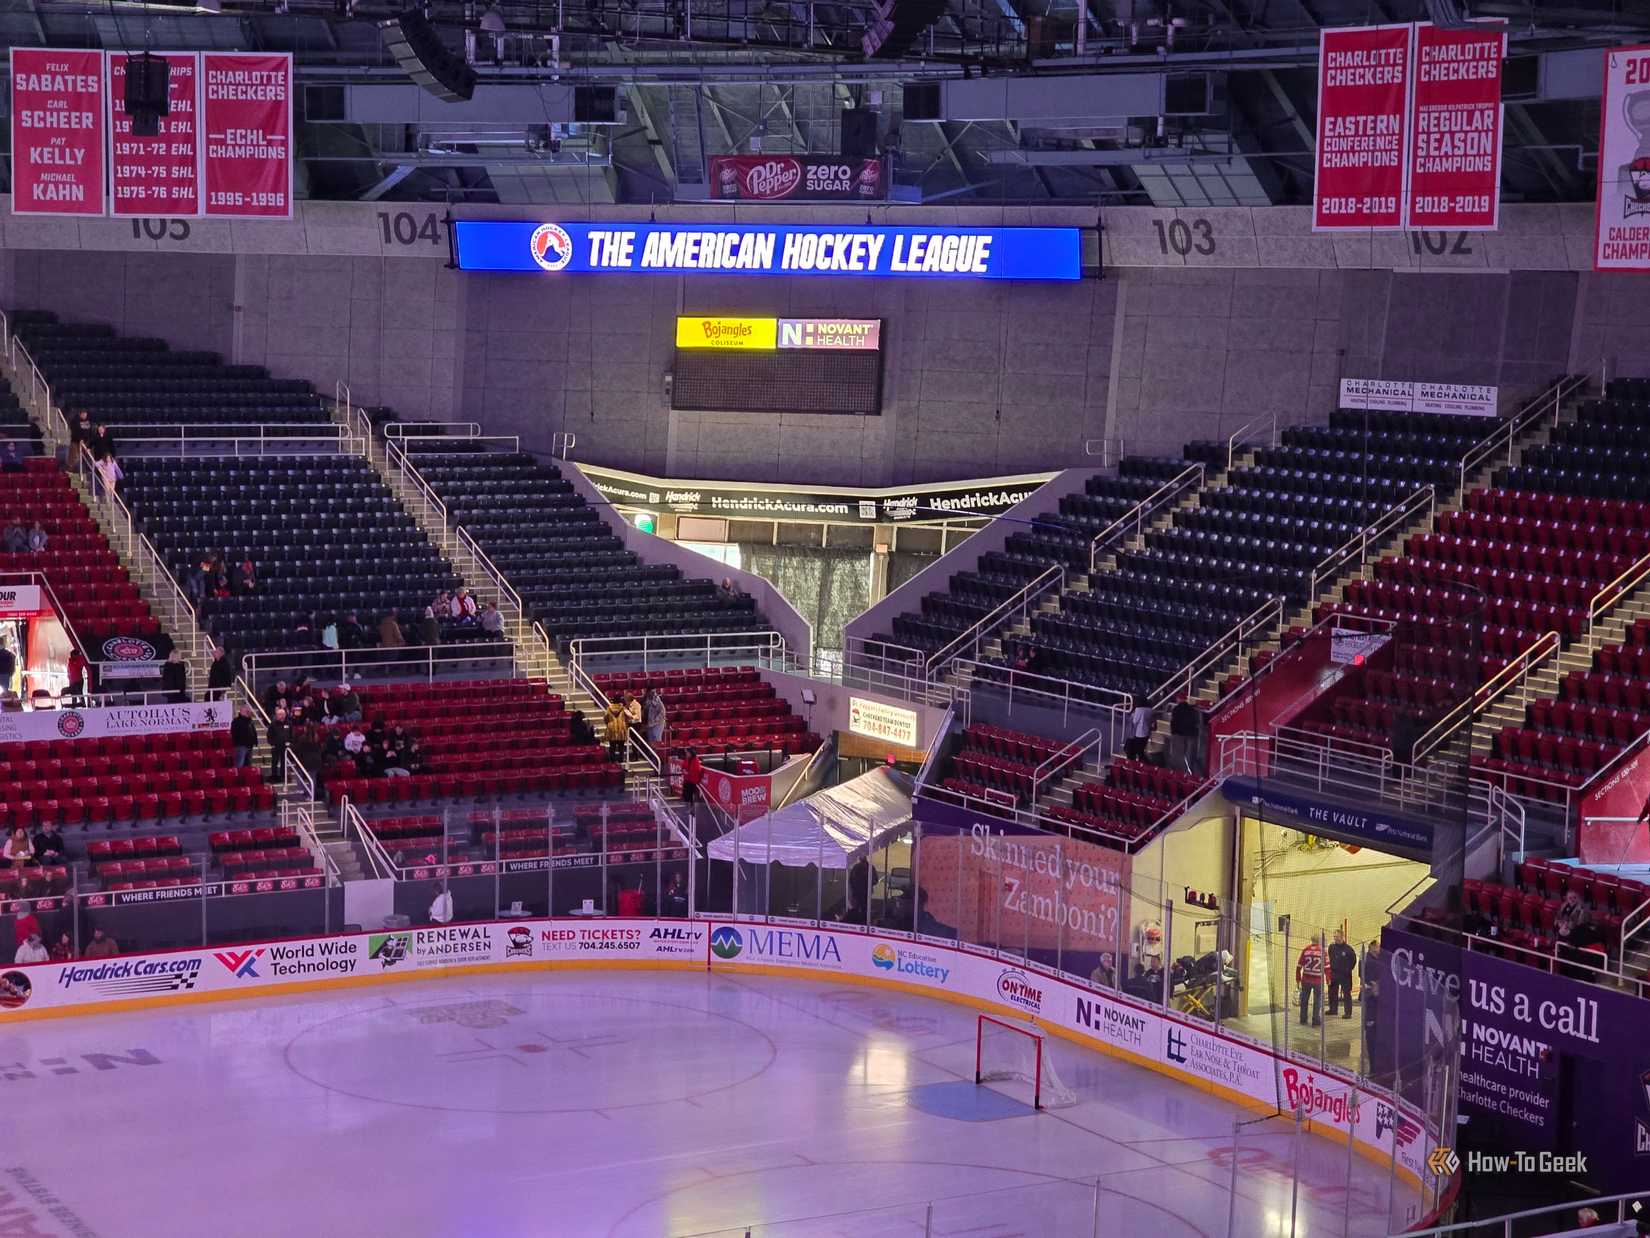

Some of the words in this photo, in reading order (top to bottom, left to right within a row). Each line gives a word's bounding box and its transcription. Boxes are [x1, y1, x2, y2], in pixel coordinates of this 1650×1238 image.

[1328, 48, 1403, 68] CHARLOTTE
[1422, 42, 1498, 62] CHARLOTTE
[46, 64, 69, 72] FELIX
[1328, 66, 1402, 86] CHECKERS
[1421, 60, 1496, 82] CHECKERS
[16, 74, 98, 92] SABATES
[208, 70, 285, 84] CHARLOTTE
[208, 84, 285, 100] CHECKERS
[48, 100, 68, 108] CARL
[170, 100, 192, 112] EHL
[22, 110, 93, 128] SCHEER
[170, 122, 192, 132] EHL
[1325, 114, 1400, 136] EASTERN
[1419, 110, 1494, 132] REGULAR
[226, 129, 268, 144] ECHL
[1324, 136, 1398, 152] CONFERENCE
[1418, 132, 1492, 156] SEASON
[30, 147, 86, 164] KELLY
[116, 143, 166, 155] 1971-72
[172, 144, 194, 155] EHL
[209, 146, 286, 159] CHAMPIONS
[1323, 151, 1398, 168] CHAMPIONS
[1416, 156, 1492, 173] CHAMPIONS
[41, 172, 76, 182] MICHAEL
[116, 166, 166, 178] 1974-75
[172, 166, 194, 178] SHL
[766, 162, 784, 176] Dr
[806, 165, 850, 180] zero
[753, 164, 796, 194] Pepper
[806, 180, 850, 191] SUGAR
[32, 184, 84, 201] KAHN
[116, 186, 167, 198] 1975-76
[172, 186, 194, 198] SHL
[210, 192, 284, 206] 1995-1996
[1322, 197, 1396, 214] 2018-2019
[1416, 196, 1489, 213] 2018-2019
[132, 218, 190, 240] 105
[377, 212, 442, 246] 104
[1153, 219, 1216, 256] 103
[1609, 227, 1650, 241] CALDER
[588, 231, 636, 268] THE
[640, 231, 776, 270] AMERICAN
[780, 233, 884, 272] HOCKEY
[890, 234, 992, 272] LEAGUE
[702, 321, 752, 338] Bojangles
[818, 324, 871, 334] NOVANT
[818, 336, 865, 346] HEALTH
[1346, 380, 1413, 389] CHARLOTTE
[1346, 387, 1414, 397] MECHANICAL
[1421, 384, 1492, 394] CHARLOTTE
[1420, 391, 1492, 401] MECHANICAL
[712, 496, 848, 515] HendrickAcura.com
[106, 718, 139, 729] LAKE
[140, 716, 190, 728] NORMAN
[107, 708, 191, 722] AUTOHAUS
[1309, 807, 1328, 821] THE
[1332, 812, 1368, 829] VAULT
[510, 860, 538, 870] WHERE
[573, 856, 594, 867] MEET
[1066, 858, 1120, 896] your
[122, 891, 154, 902] WHERE
[155, 888, 193, 900] FRIENDS
[194, 886, 218, 898] MET
[1004, 876, 1118, 941] Zamboni?
[417, 926, 491, 945] RENEWAL
[542, 930, 576, 941] NEED
[580, 930, 642, 940] TICKETS?
[270, 944, 315, 960] World
[318, 940, 358, 956] Wide
[416, 947, 426, 956] by
[428, 940, 491, 955] ANDERSEN
[542, 942, 564, 950] TEXT
[566, 942, 577, 950] US
[578, 942, 641, 950] 704.245.6507
[750, 928, 842, 962] MEMA
[908, 952, 937, 963] Education
[1304, 956, 1321, 972] 22
[58, 962, 132, 988] Hendrick
[134, 958, 202, 976] Cars.com
[271, 957, 358, 976] Technology
[898, 958, 950, 984] Lottery
[1010, 994, 1041, 1010] ELECTRICAL
[1391, 948, 1461, 1001] Give
[1469, 978, 1505, 1014] us
[1513, 992, 1532, 1023] a
[1539, 996, 1600, 1044] call
[1104, 1008, 1146, 1032] NOVANT
[1104, 1022, 1142, 1047] HEALTH
[1472, 1022, 1548, 1058] NOVANT
[1472, 1042, 1540, 1080] HEALTH
[1509, 1087, 1550, 1109] provider
[1459, 1087, 1498, 1110] harlotte
[1500, 1100, 1545, 1127] Checkers
